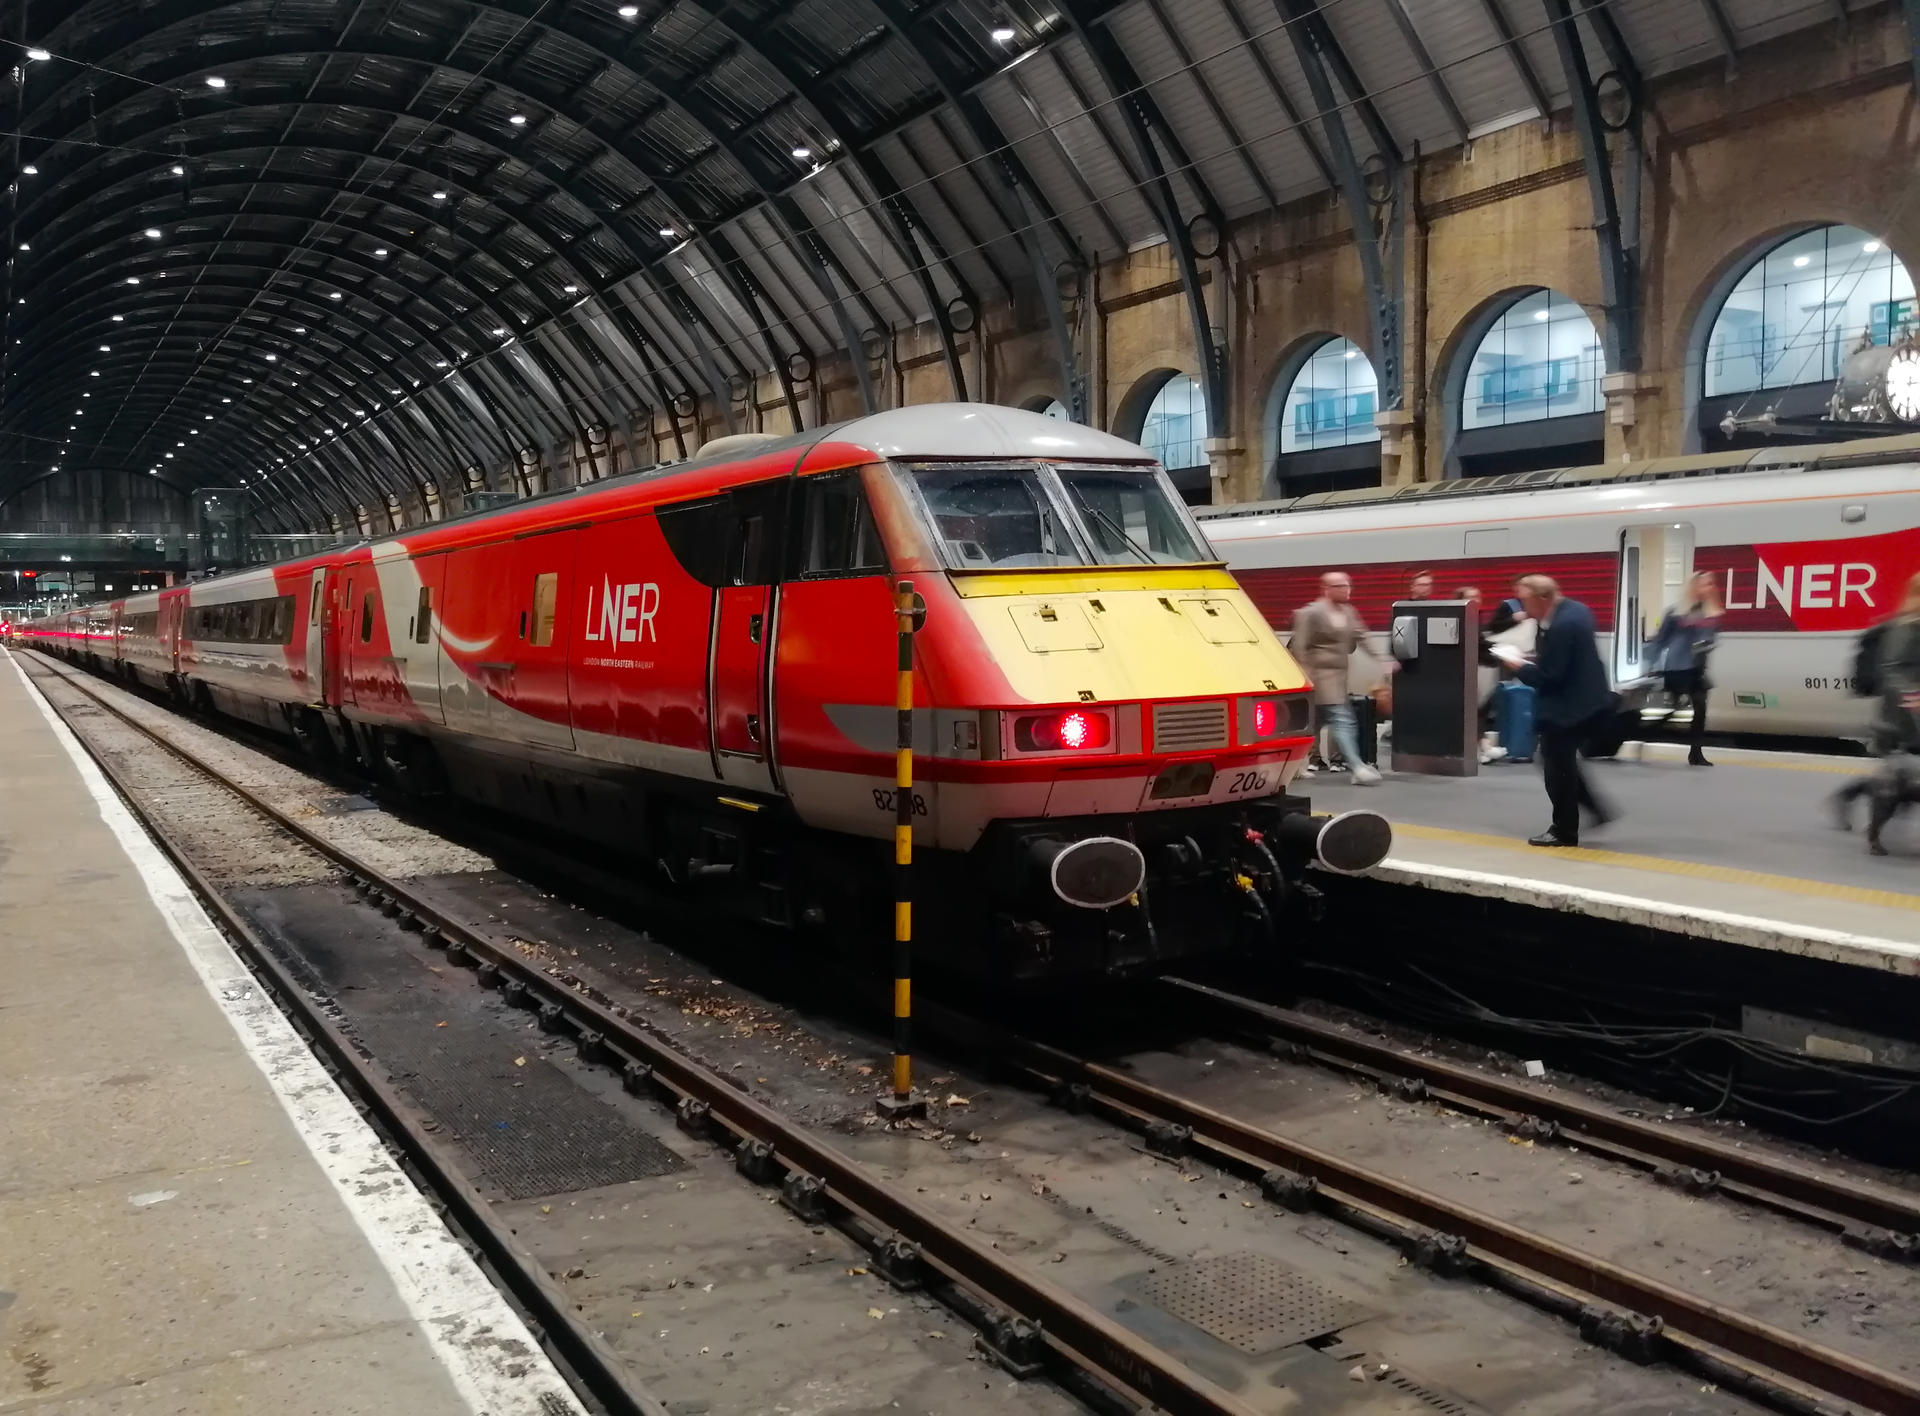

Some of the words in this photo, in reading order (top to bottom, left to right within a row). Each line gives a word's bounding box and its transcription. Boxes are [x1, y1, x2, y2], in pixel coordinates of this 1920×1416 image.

[1725, 556, 1877, 618] LNER
[585, 572, 660, 653] LNER
[600, 658, 614, 667] NORTH
[614, 659, 634, 669] EASTERN
[1805, 677, 1828, 689] 801
[1228, 769, 1269, 794] 208
[872, 788, 928, 816] 828
